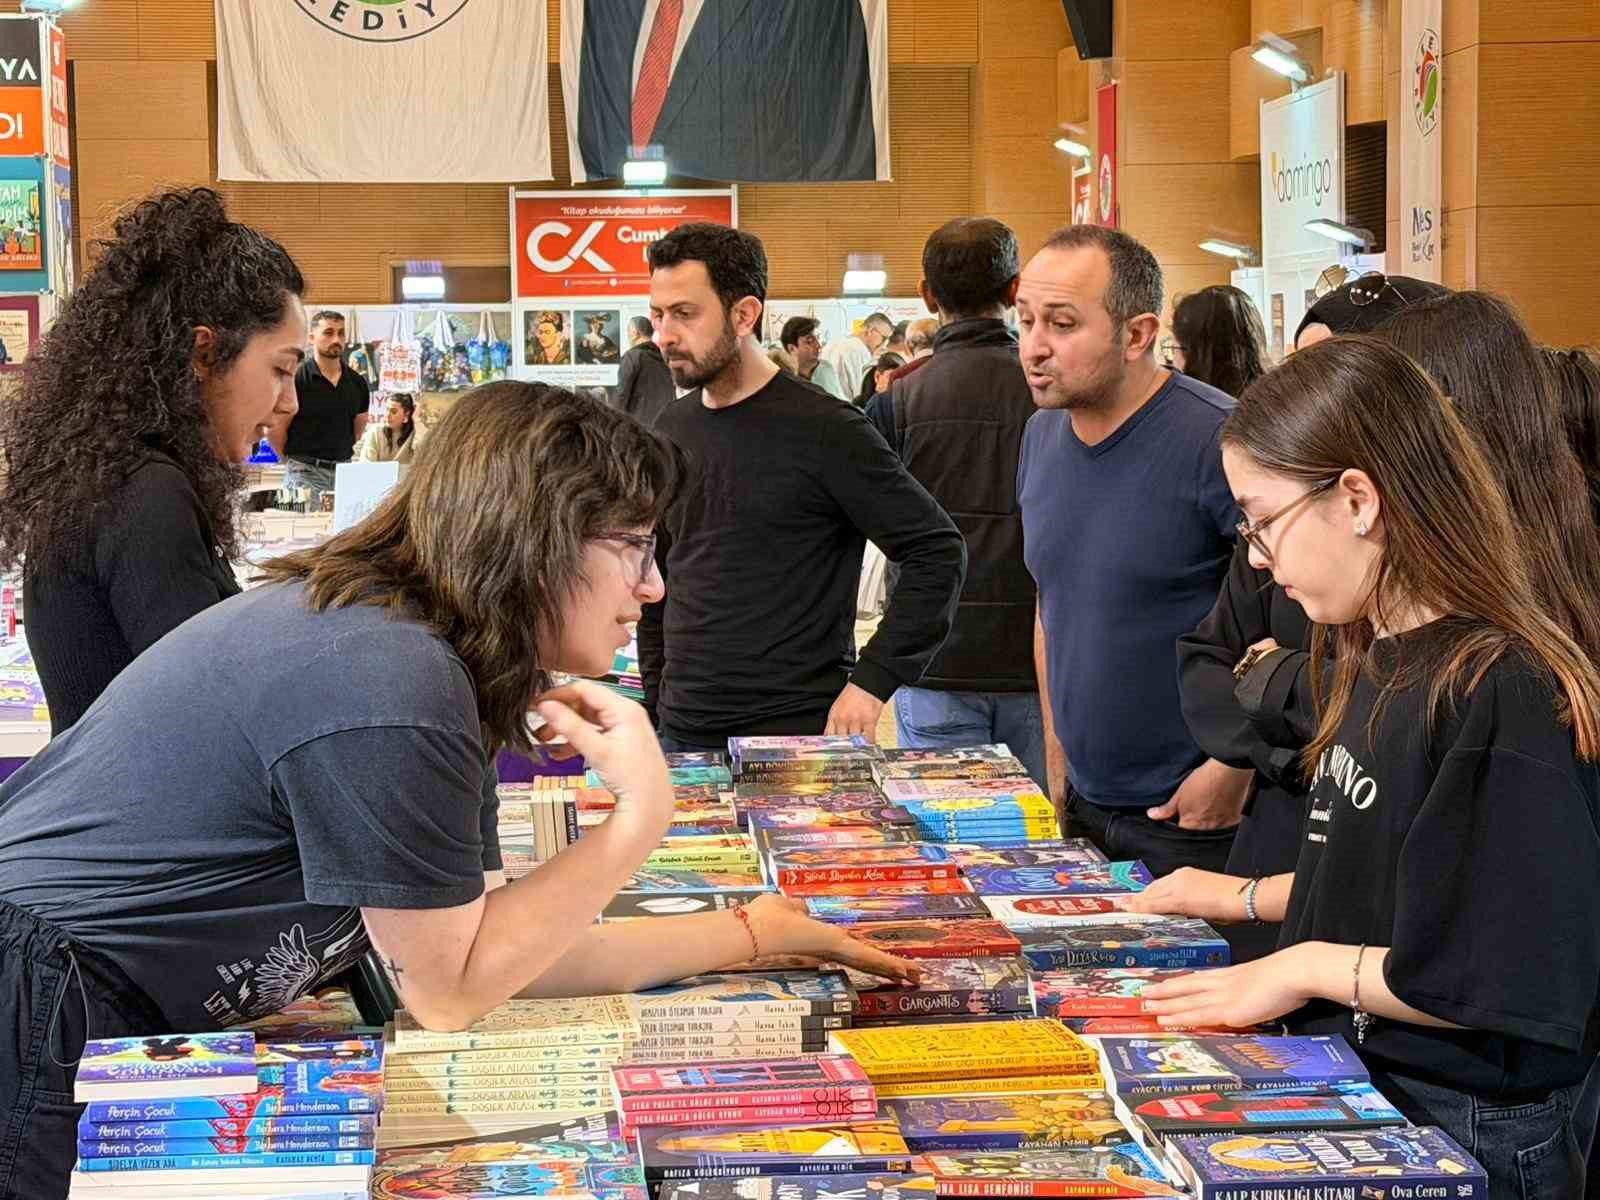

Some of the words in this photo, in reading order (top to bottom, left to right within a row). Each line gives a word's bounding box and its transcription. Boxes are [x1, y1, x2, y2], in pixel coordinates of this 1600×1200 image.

[1277, 151, 1331, 207] domingo
[107, 1105, 140, 1119] Perçin
[143, 1102, 177, 1120] Çocuk
[294, 1101, 341, 1114] Henderson
[97, 1125, 131, 1139] Perçin
[134, 1122, 168, 1139] Çocuk
[285, 1122, 331, 1134] Henderson
[97, 1142, 131, 1155] Perçin
[134, 1140, 168, 1156] Çocuk
[285, 1139, 331, 1150] Henderson
[663, 1167, 691, 1179] HAFIZA
[1391, 1184, 1414, 1198] Ova
[1415, 1182, 1448, 1198] Ceren
